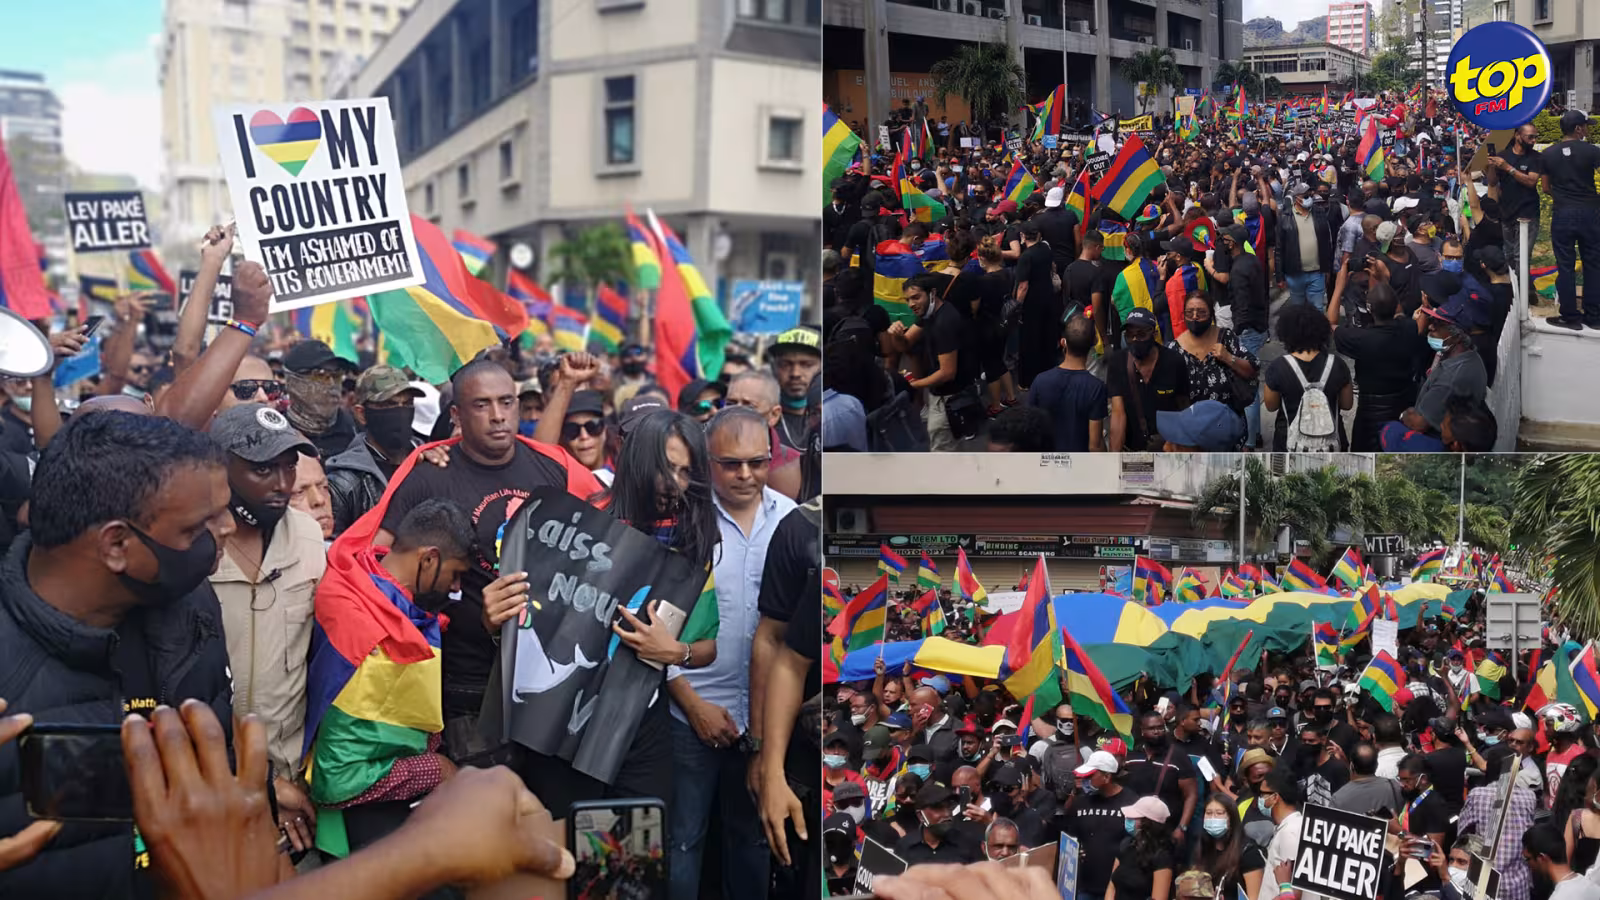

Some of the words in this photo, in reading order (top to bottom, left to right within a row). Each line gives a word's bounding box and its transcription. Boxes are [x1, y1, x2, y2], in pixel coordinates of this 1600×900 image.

[233, 114, 256, 178] I
[321, 106, 378, 170] MY
[1093, 161, 1105, 170] OUT
[67, 201, 98, 220] LEV
[101, 196, 144, 219] PAKÉ
[250, 173, 389, 235] COUNTRY
[74, 221, 149, 248] ALLER
[300, 231, 376, 266] ASHAMED
[380, 226, 400, 252] OF
[270, 269, 302, 296] ITS
[911, 535, 937, 543] MEEM
[939, 535, 957, 543] LTD
[1364, 535, 1404, 552] WTF?!
[1303, 817, 1336, 846] LEV
[1336, 828, 1382, 859] PAKÉ
[1294, 847, 1376, 899] ALLER
